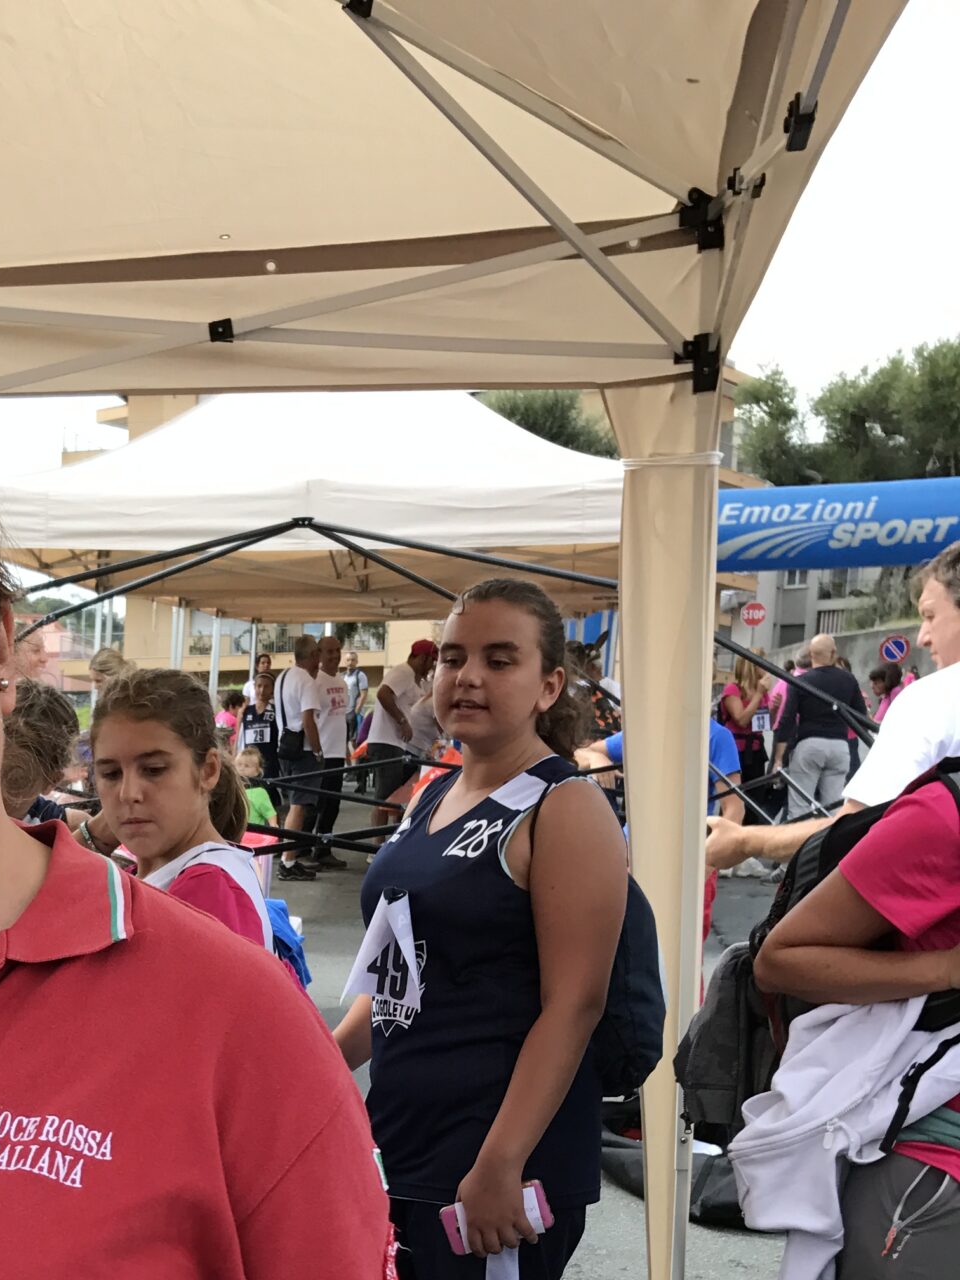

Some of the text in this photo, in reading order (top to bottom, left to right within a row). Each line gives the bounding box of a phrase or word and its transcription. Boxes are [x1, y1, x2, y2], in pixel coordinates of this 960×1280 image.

[718, 495, 879, 526] Emozioni
[827, 516, 959, 550] SPORT
[742, 609, 766, 620] STOP
[253, 729, 265, 743] 29
[366, 938, 410, 1001] 49
[38, 1114, 113, 1161] ROSSA
